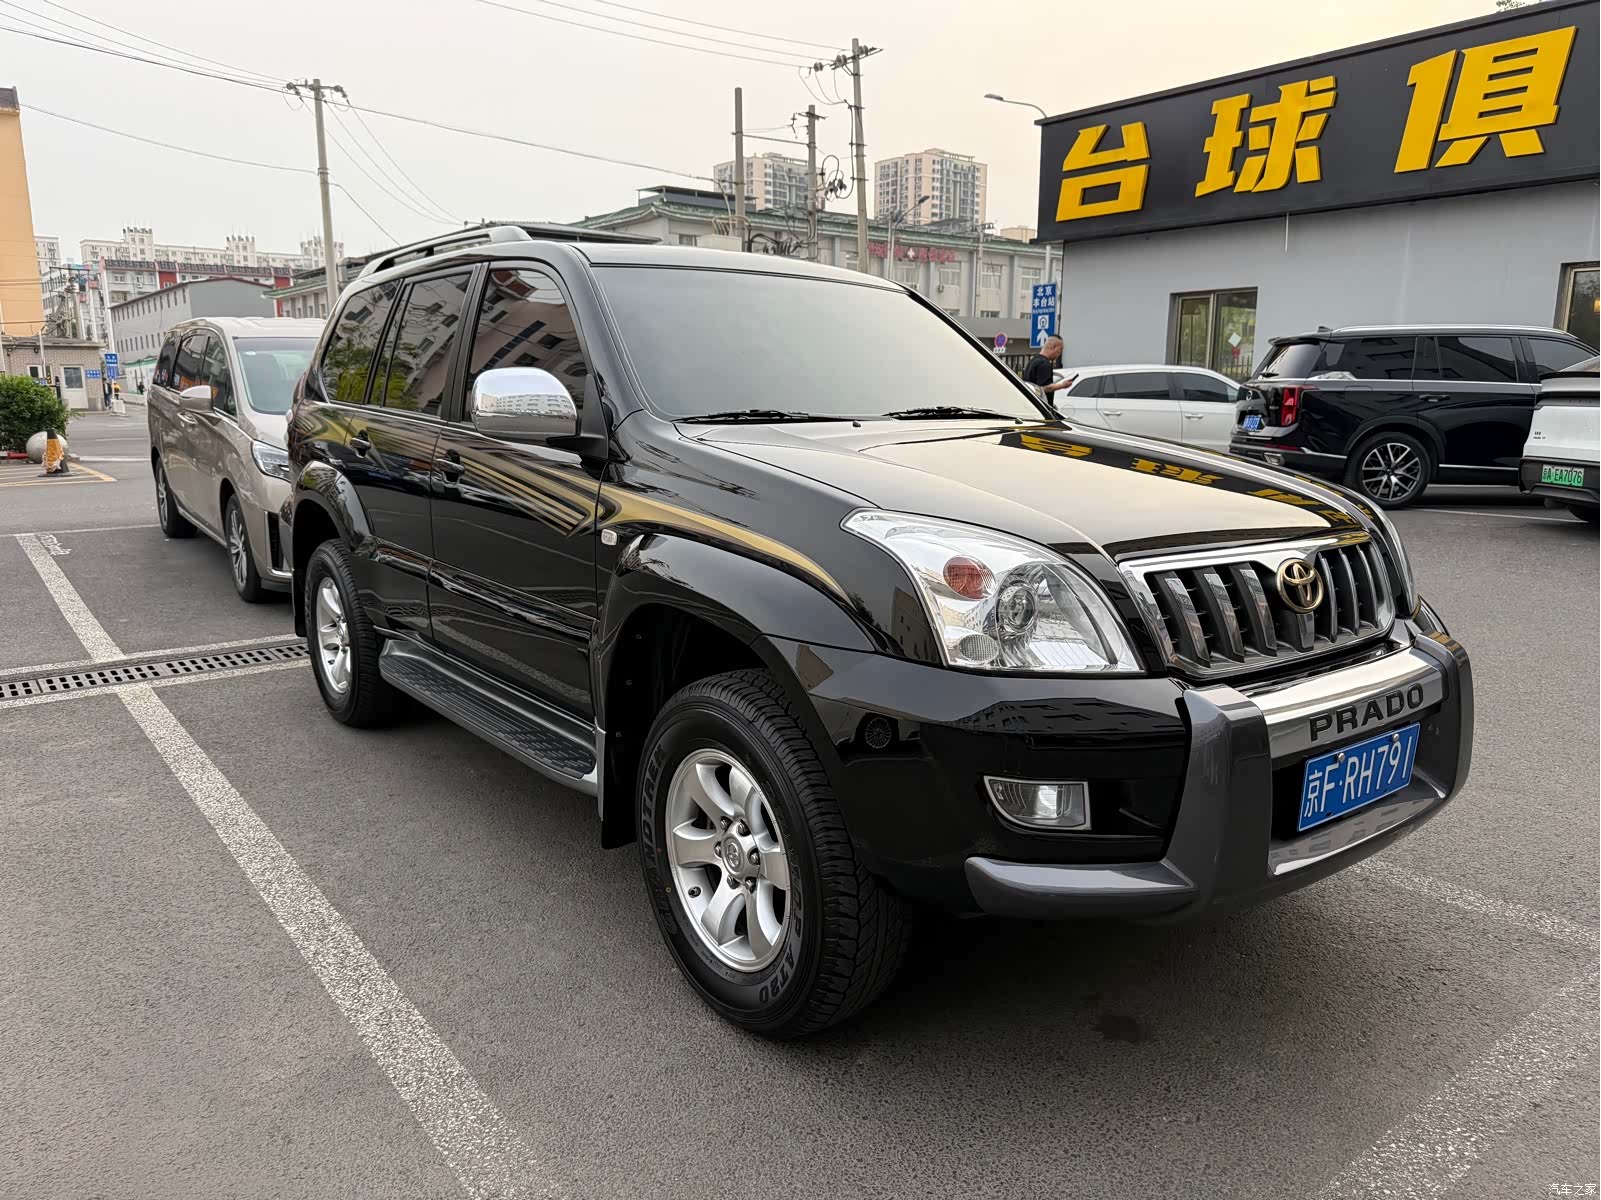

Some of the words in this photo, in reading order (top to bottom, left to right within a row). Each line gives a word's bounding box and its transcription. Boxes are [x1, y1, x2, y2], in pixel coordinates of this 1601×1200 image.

[1033, 297, 1055, 308] 丰台站
[1037, 286, 1053, 297] 北京
[1309, 683, 1424, 742] PRADO
[1304, 736, 1412, 818] 京F·RH791
[759, 943, 802, 1004] AT20
